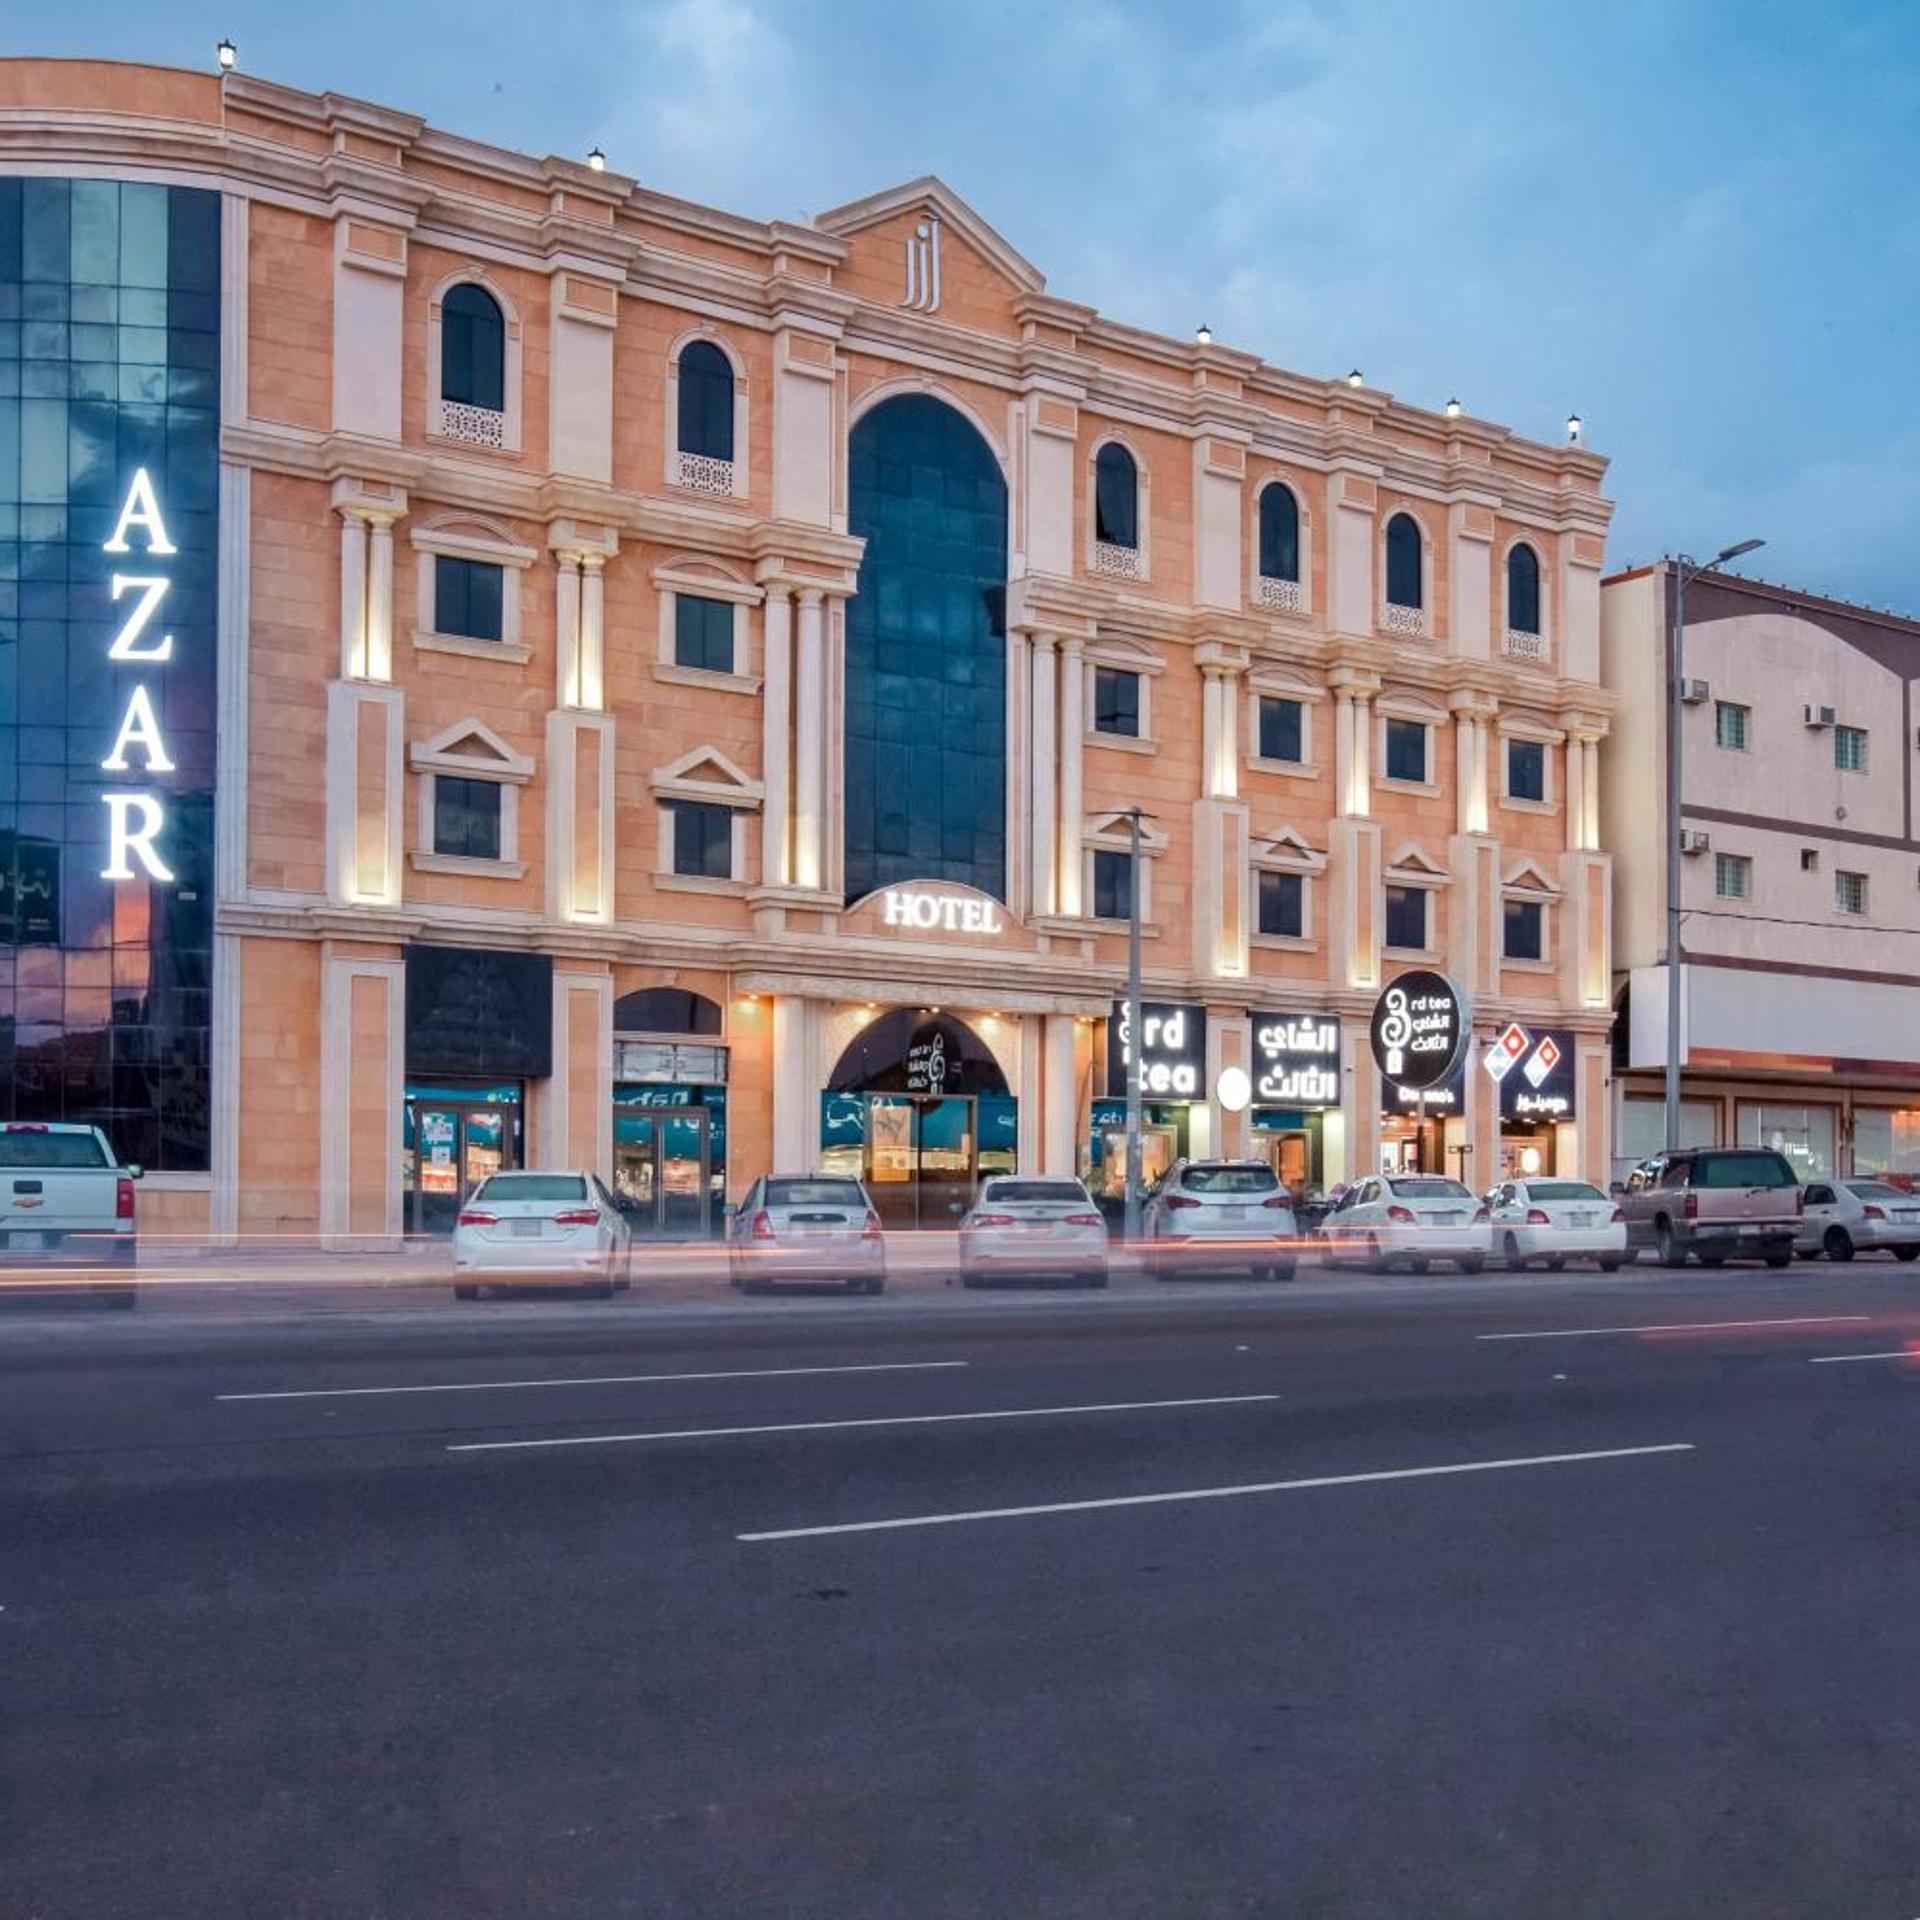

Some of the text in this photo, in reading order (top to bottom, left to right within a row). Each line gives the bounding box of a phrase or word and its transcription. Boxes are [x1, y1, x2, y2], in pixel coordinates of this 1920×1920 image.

[101, 467, 177, 881] AZAR
[884, 890, 1002, 934] HOTEL
[1411, 996, 1426, 1011] rd
[1428, 996, 1451, 1010] tea
[1411, 1012, 1450, 1032] الشاي
[1144, 1010, 1184, 1048] rd
[1259, 1017, 1336, 1058] الشاي
[1138, 1058, 1196, 1092] tea
[1259, 1064, 1336, 1100] الثالث
